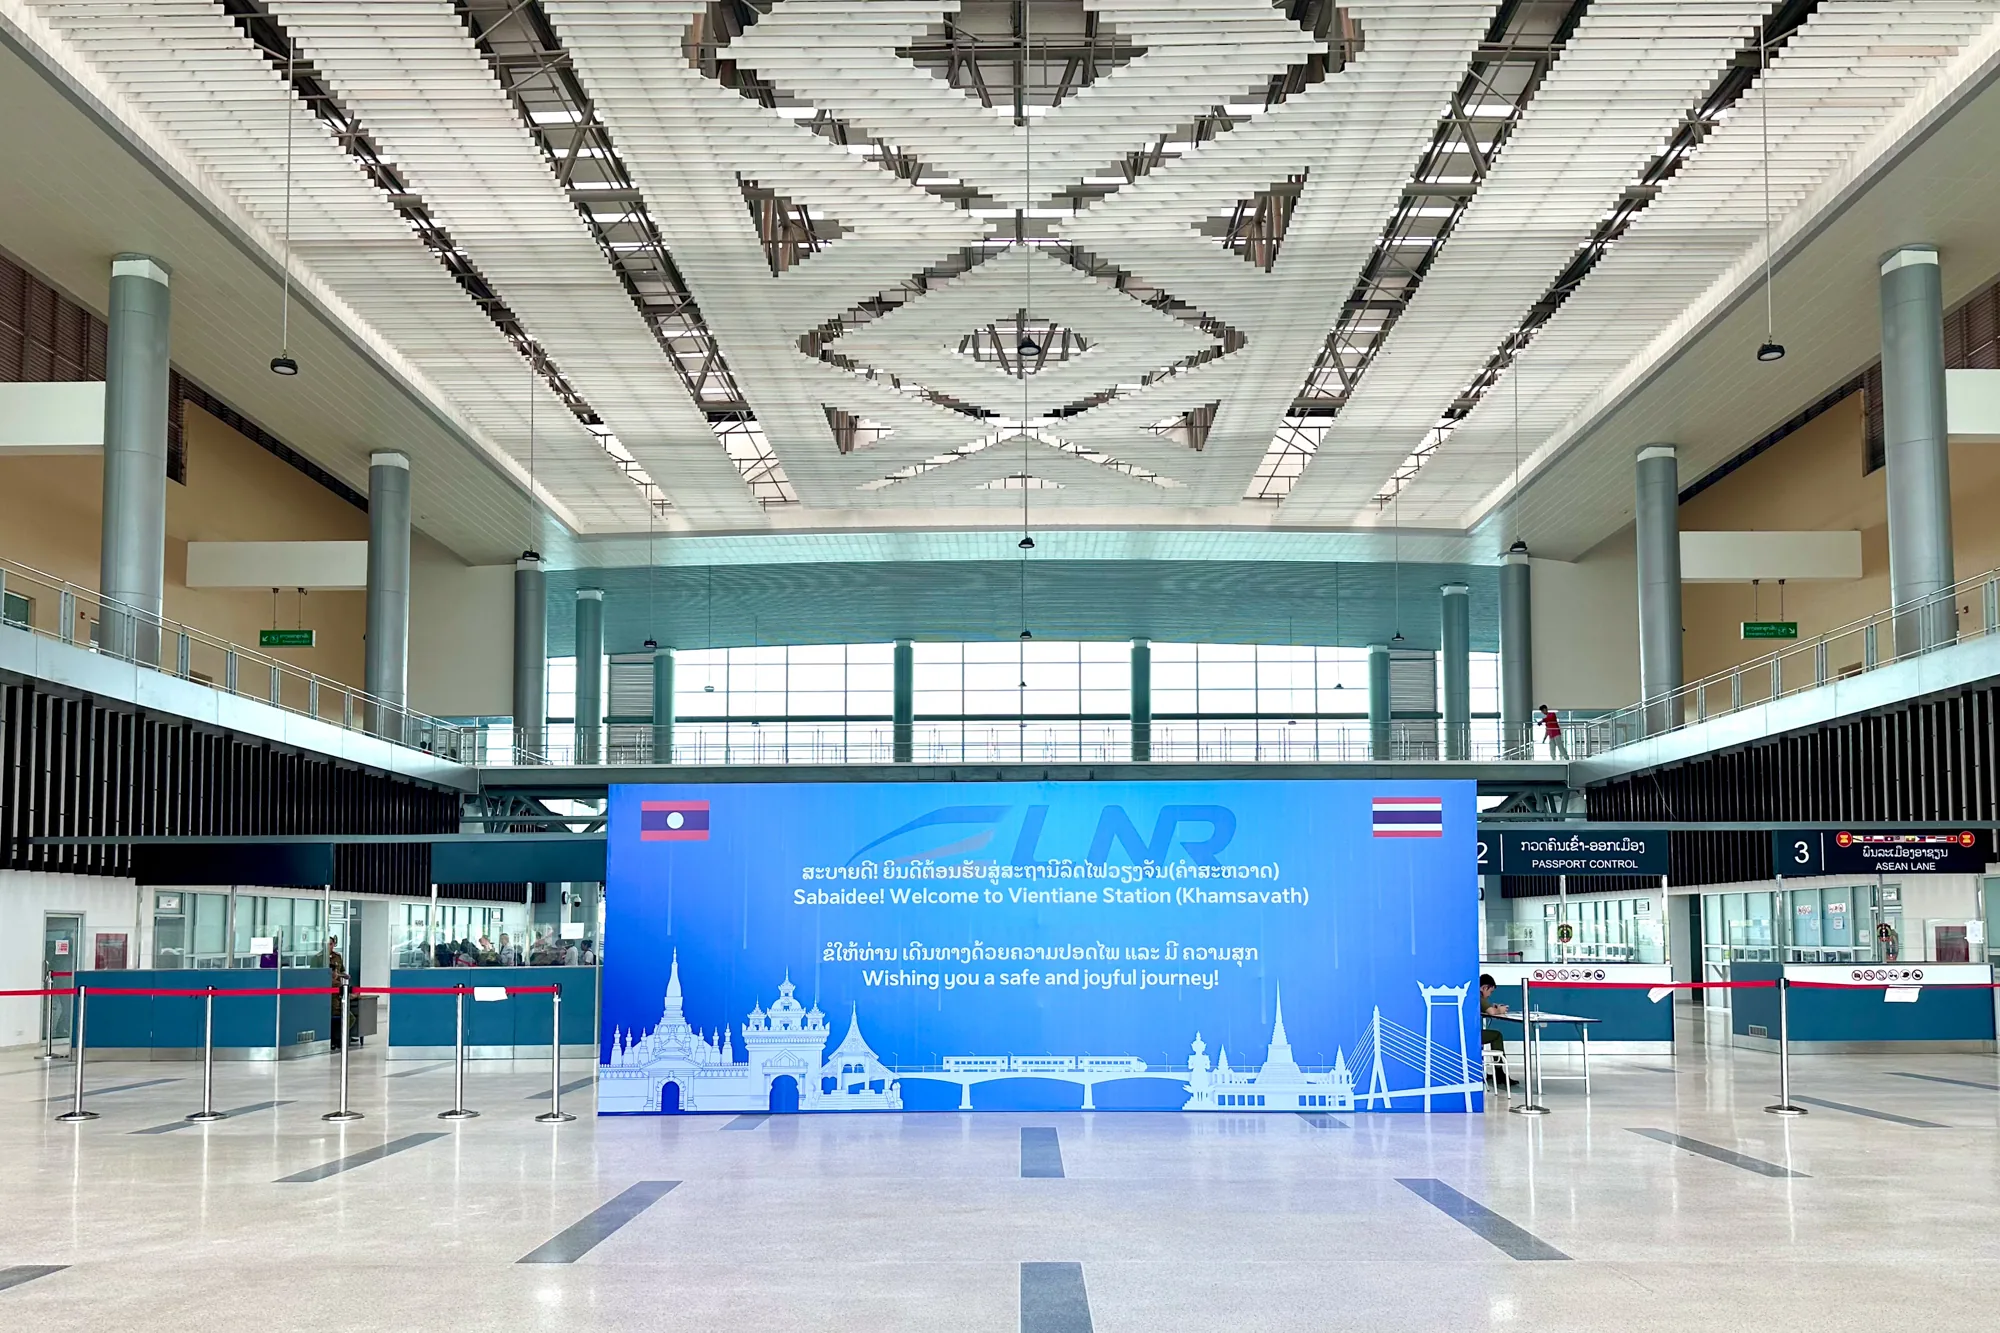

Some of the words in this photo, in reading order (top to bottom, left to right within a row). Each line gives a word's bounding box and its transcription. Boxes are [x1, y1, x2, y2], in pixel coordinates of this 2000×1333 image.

[1476, 842, 1489, 864] 2
[1794, 841, 1810, 864] 3
[802, 859, 878, 880] ສະບາຍດີ!
[1532, 859, 1587, 869] PASSPORT
[1589, 859, 1639, 869] CONTROL
[1875, 862, 1909, 871] ASEAN
[1911, 862, 1937, 871] LANE
[794, 888, 884, 905] Sabaidee!
[890, 887, 979, 904] Welcome
[984, 890, 1003, 904] to
[1008, 887, 1098, 903] Vientiane
[1103, 887, 1171, 904] Station
[1176, 887, 1309, 906] (Khamsavath)
[1126, 946, 1160, 961] ແລະ
[1165, 940, 1181, 961] ມີ
[1183, 946, 1259, 968] ຄວາມສຸກ
[862, 969, 939, 990] Wishing
[944, 973, 979, 990] you
[984, 973, 995, 986] a
[1000, 968, 1040, 986] safe
[1044, 968, 1079, 986] and
[1082, 968, 1137, 990] joyful
[1139, 969, 1219, 990] journey!
